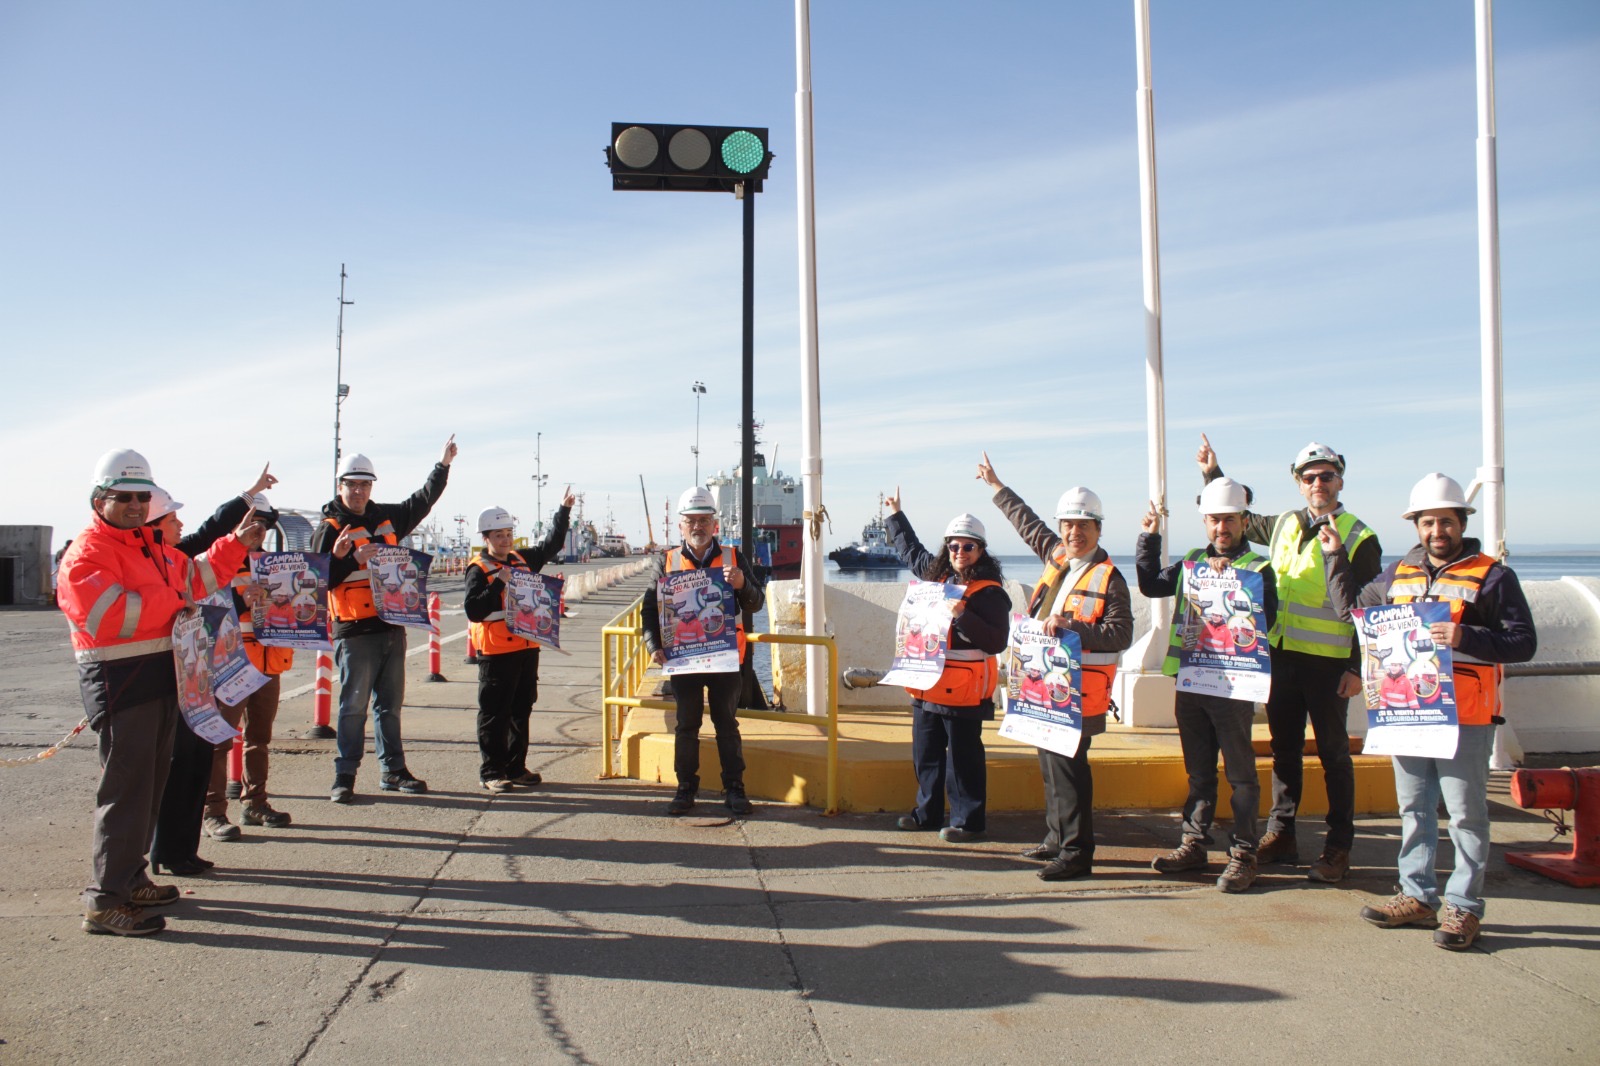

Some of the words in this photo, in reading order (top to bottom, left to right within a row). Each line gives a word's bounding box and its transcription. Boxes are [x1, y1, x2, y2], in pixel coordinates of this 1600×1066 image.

[378, 548, 410, 556] CAMPAÑA
[265, 553, 304, 565] CAMPAÑA
[514, 572, 542, 583] CAMPAÑA
[670, 569, 706, 585] CAMPAÑA
[692, 580, 710, 588] VIENTO
[1201, 580, 1209, 589] NO
[1220, 581, 1238, 589] VIENTO
[1370, 605, 1415, 624] CAMPAÑA
[1377, 624, 1387, 634] NO
[1398, 619, 1419, 631] VIENTO
[1023, 635, 1030, 644] NO
[679, 647, 707, 655] SEGURIDAD
[1199, 658, 1233, 666] SEGURIDAD
[1022, 708, 1050, 719] SEGURIDAD
[1048, 709, 1071, 720] AUMENTA,
